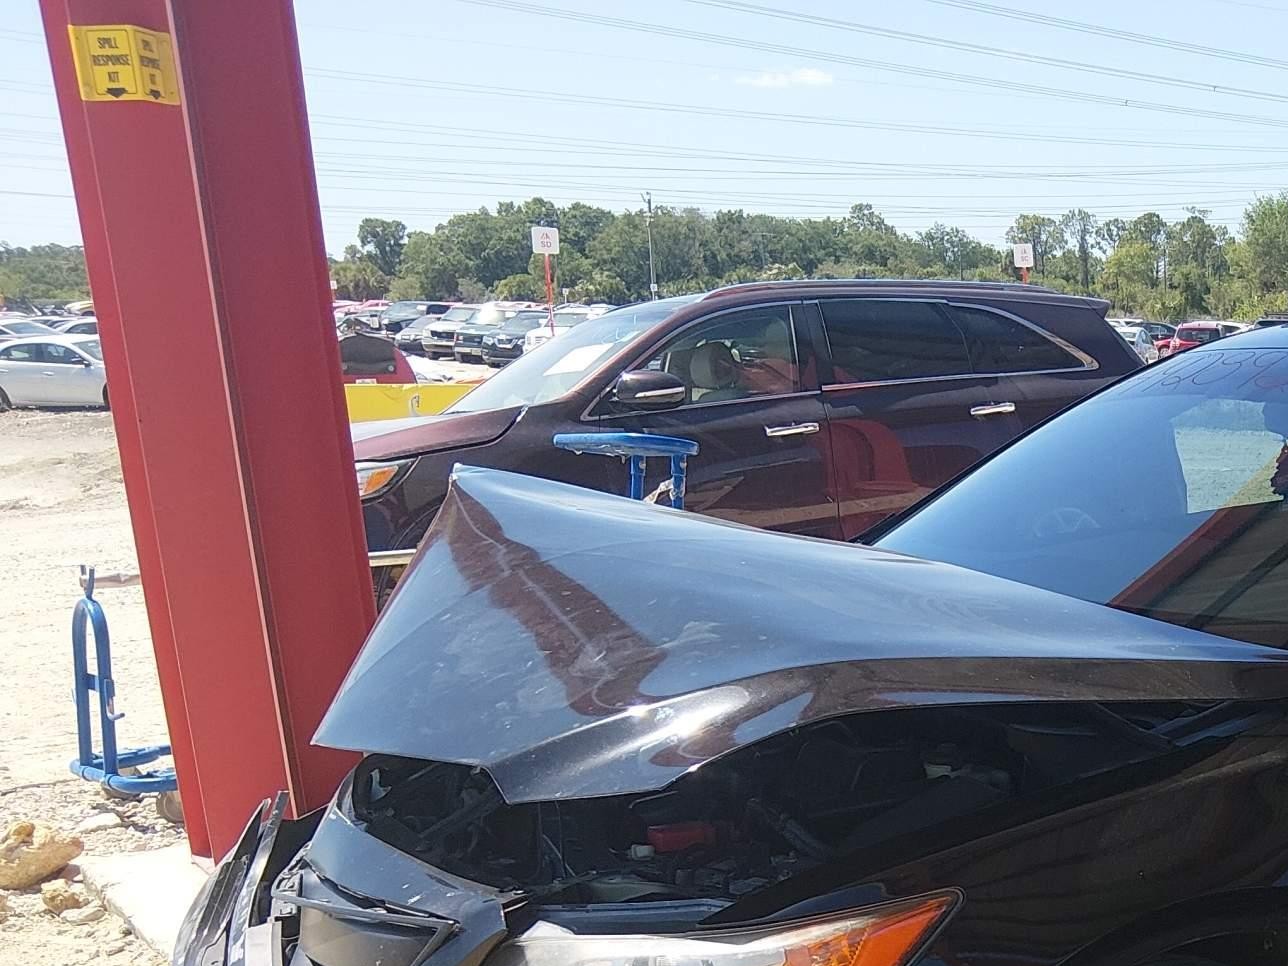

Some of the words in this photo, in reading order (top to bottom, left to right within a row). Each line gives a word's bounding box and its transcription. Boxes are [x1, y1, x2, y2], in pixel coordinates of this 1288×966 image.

[97, 37, 118, 49] SPILL
[92, 54, 131, 66] RESPONSE
[107, 72, 120, 83] KIT
